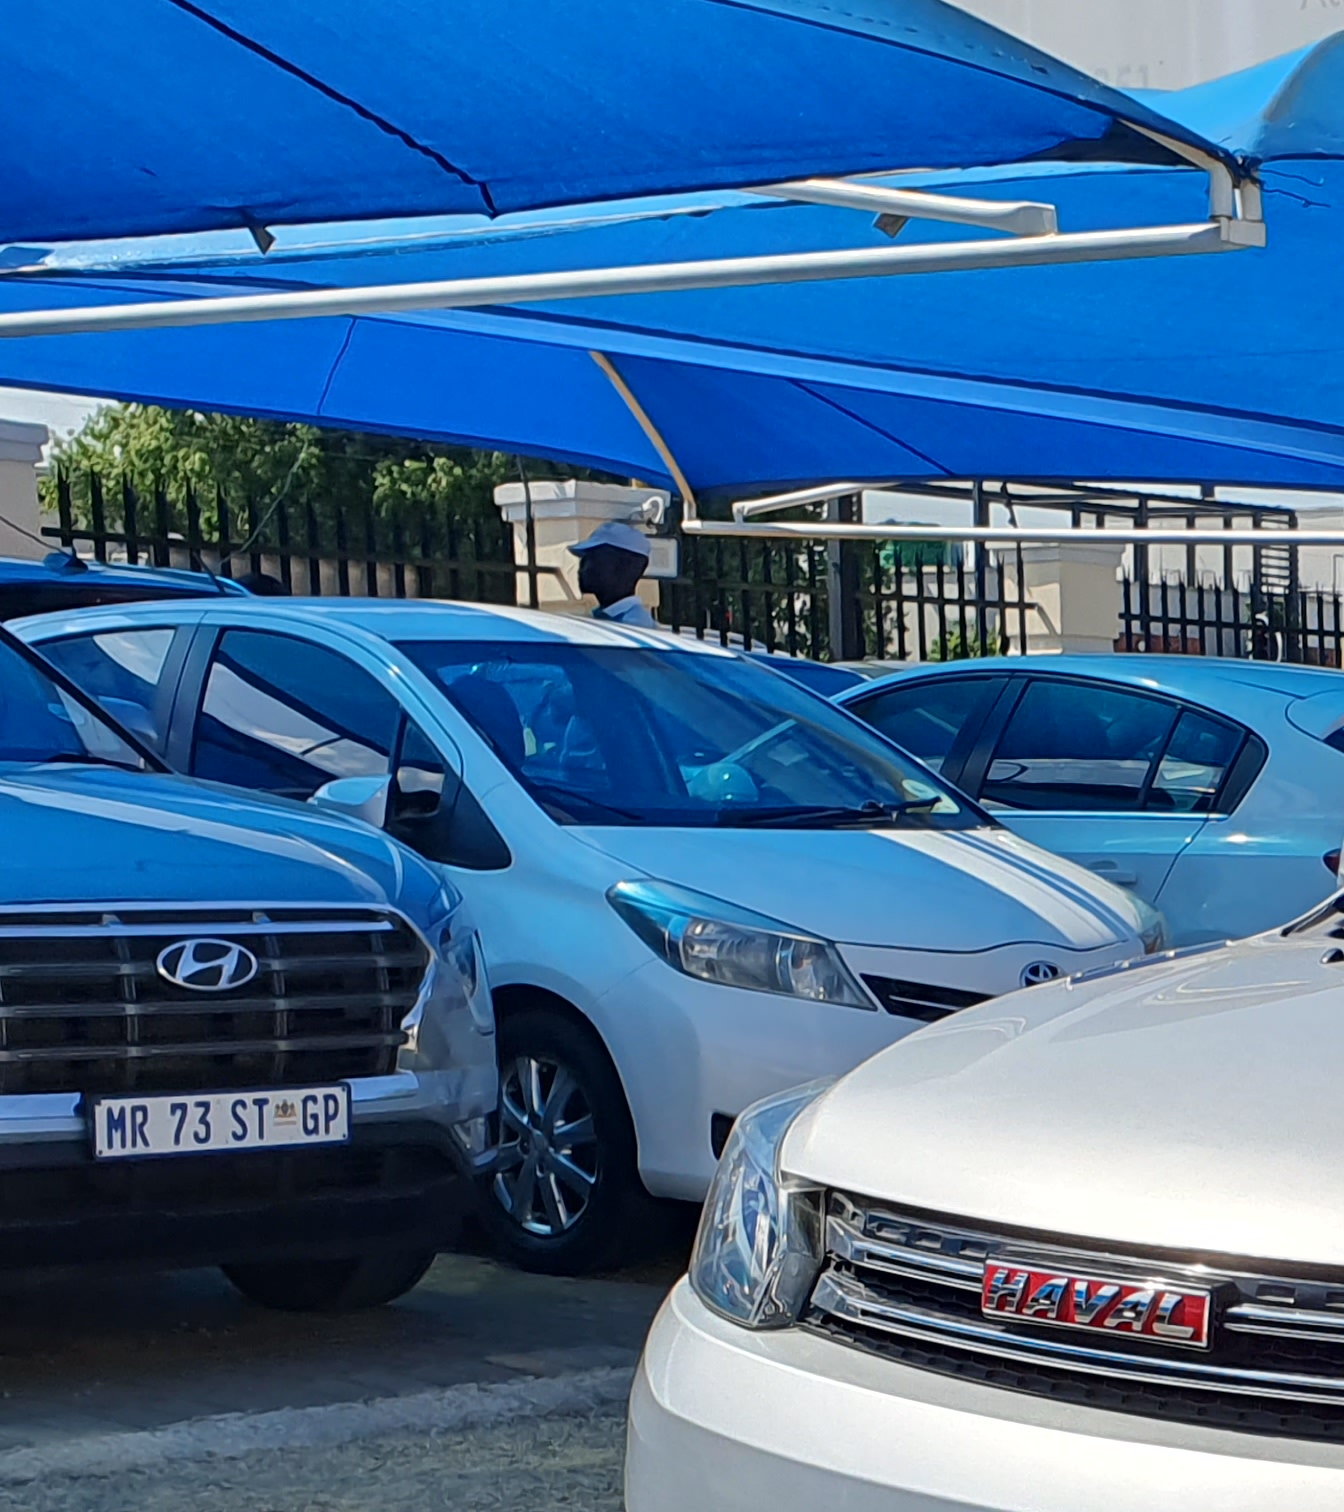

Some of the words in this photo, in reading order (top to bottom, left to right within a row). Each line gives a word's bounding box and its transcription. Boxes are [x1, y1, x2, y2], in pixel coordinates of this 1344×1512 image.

[106, 1104, 150, 1150] MR
[170, 1101, 212, 1145] 73
[231, 1098, 270, 1141] ST
[302, 1093, 339, 1136] GP
[988, 1269, 1195, 1338] HAVAL
